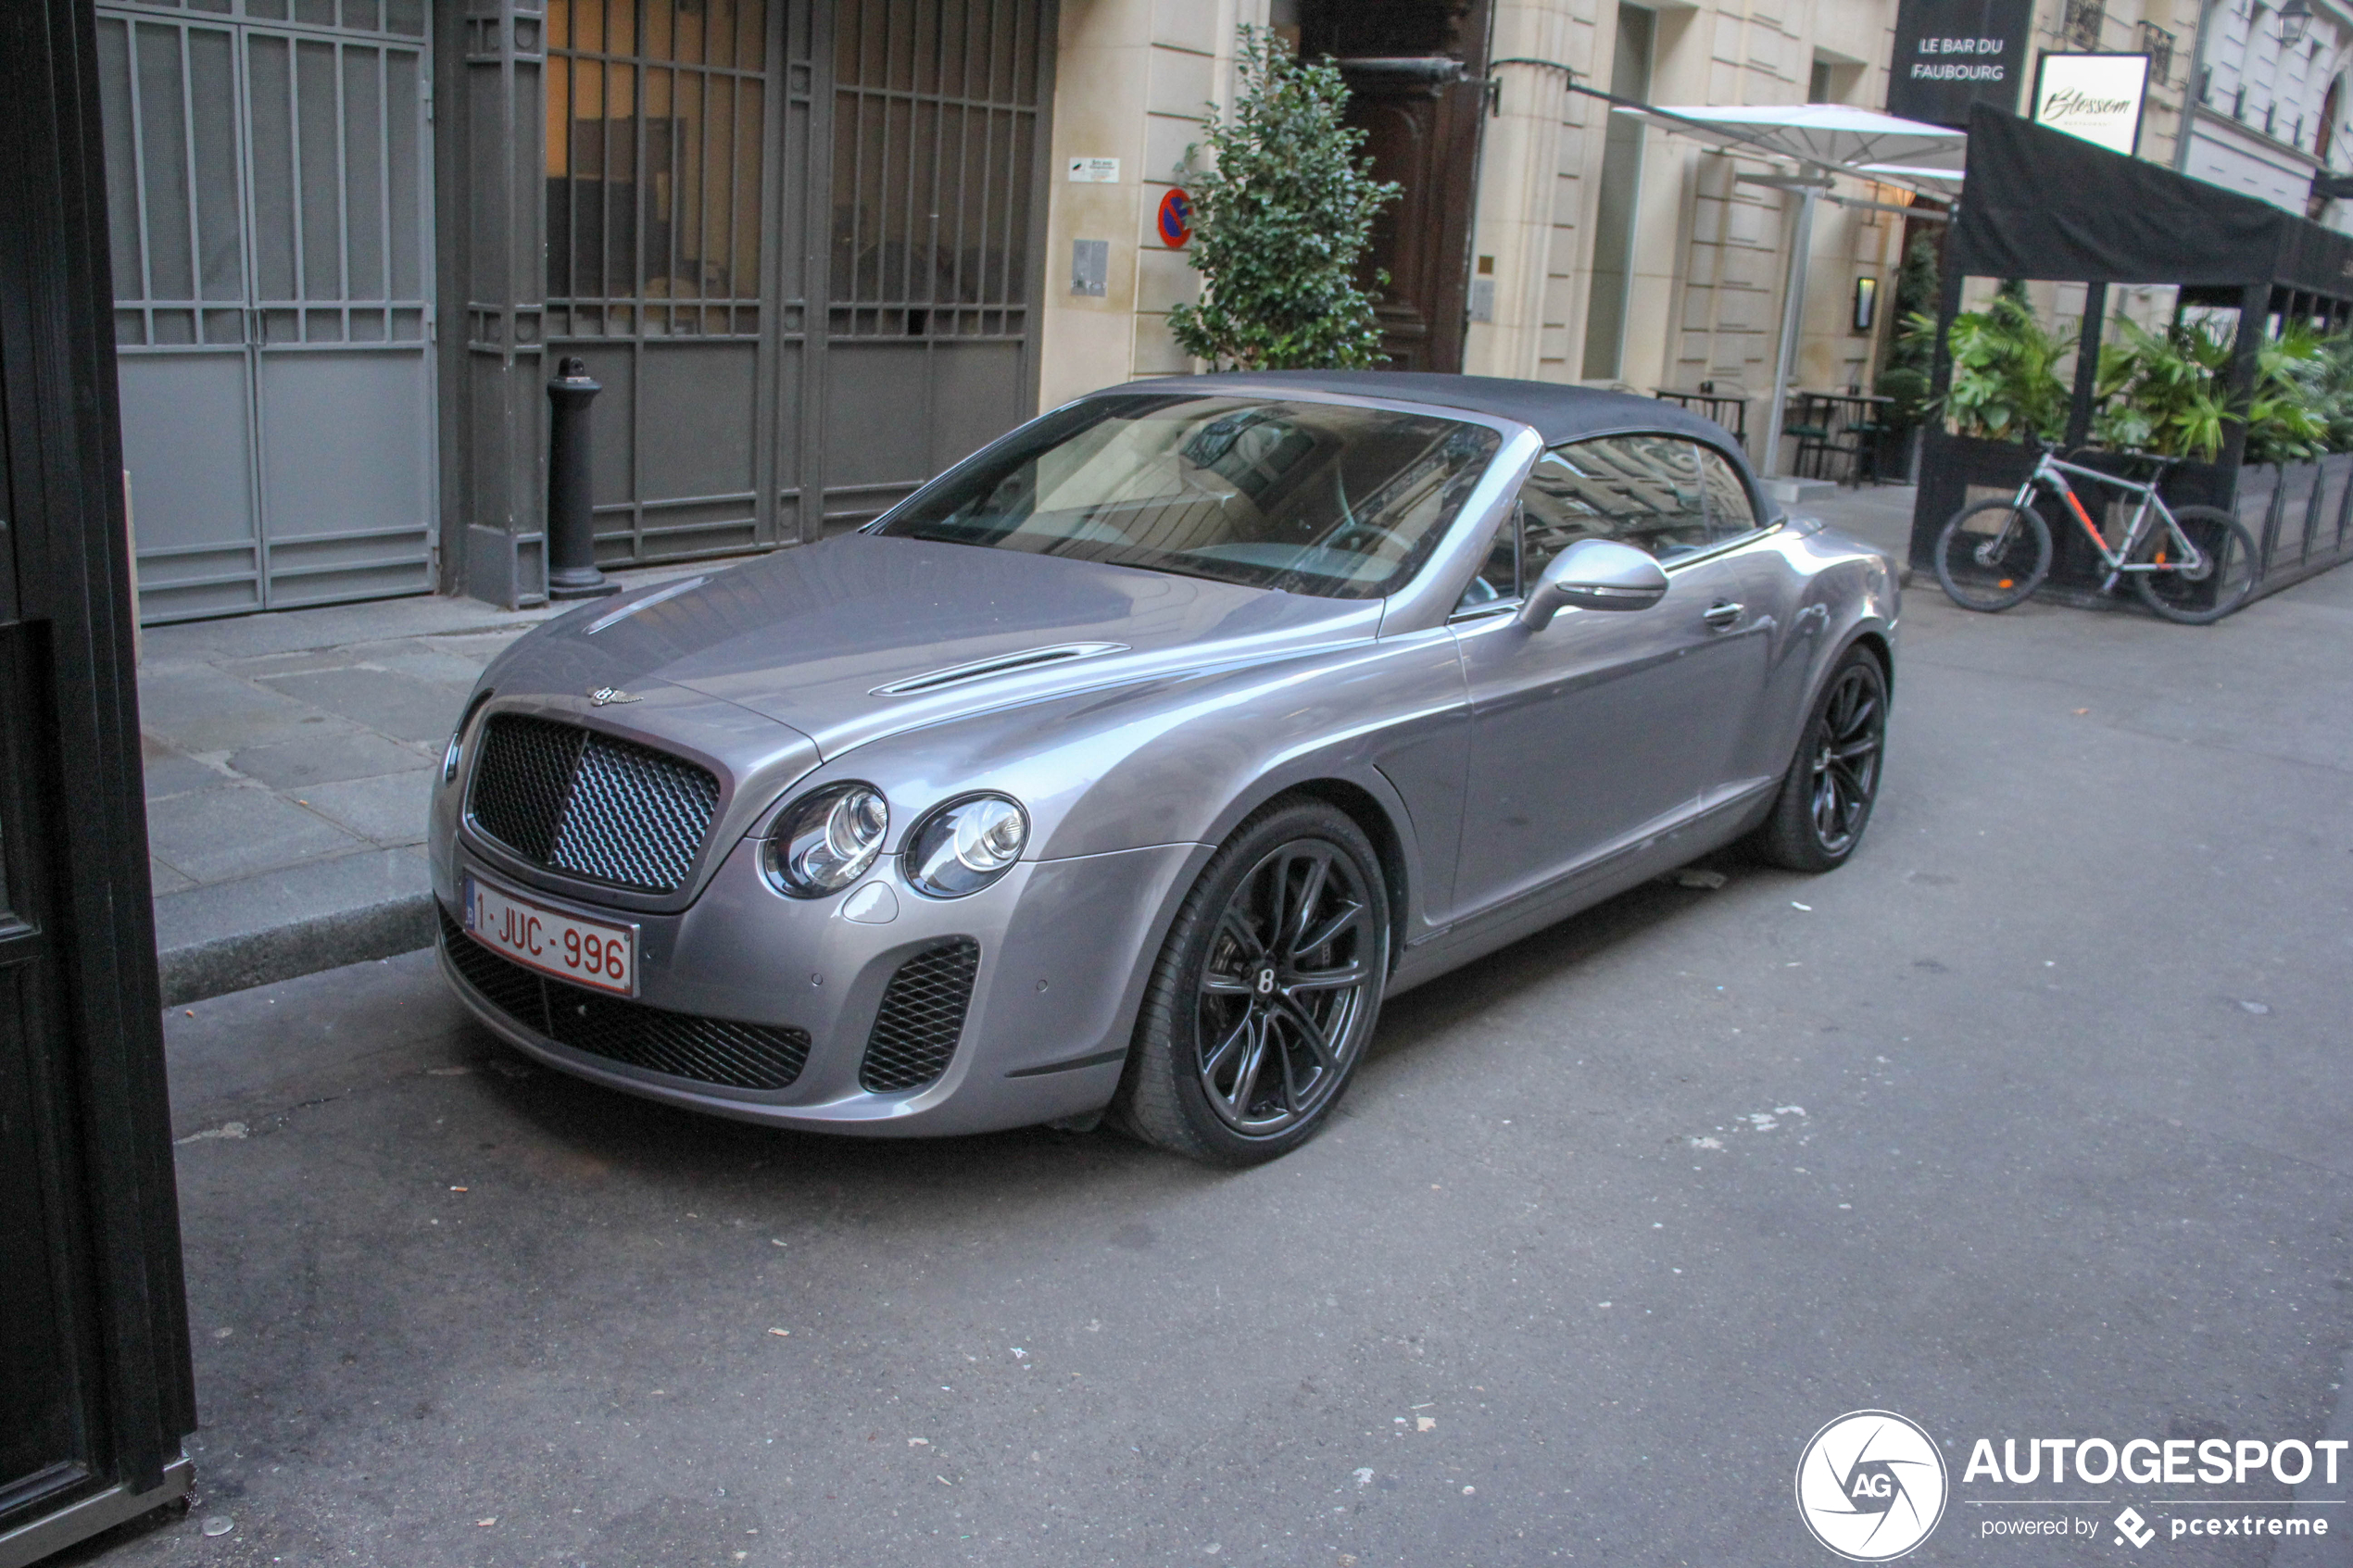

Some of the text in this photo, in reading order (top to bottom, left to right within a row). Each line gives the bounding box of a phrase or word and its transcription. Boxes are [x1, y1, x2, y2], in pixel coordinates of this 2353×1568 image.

[1919, 38, 2004, 55] LE BAR DU
[1910, 64, 2004, 82] FAUBOURG
[2044, 86, 2131, 121] Blossom
